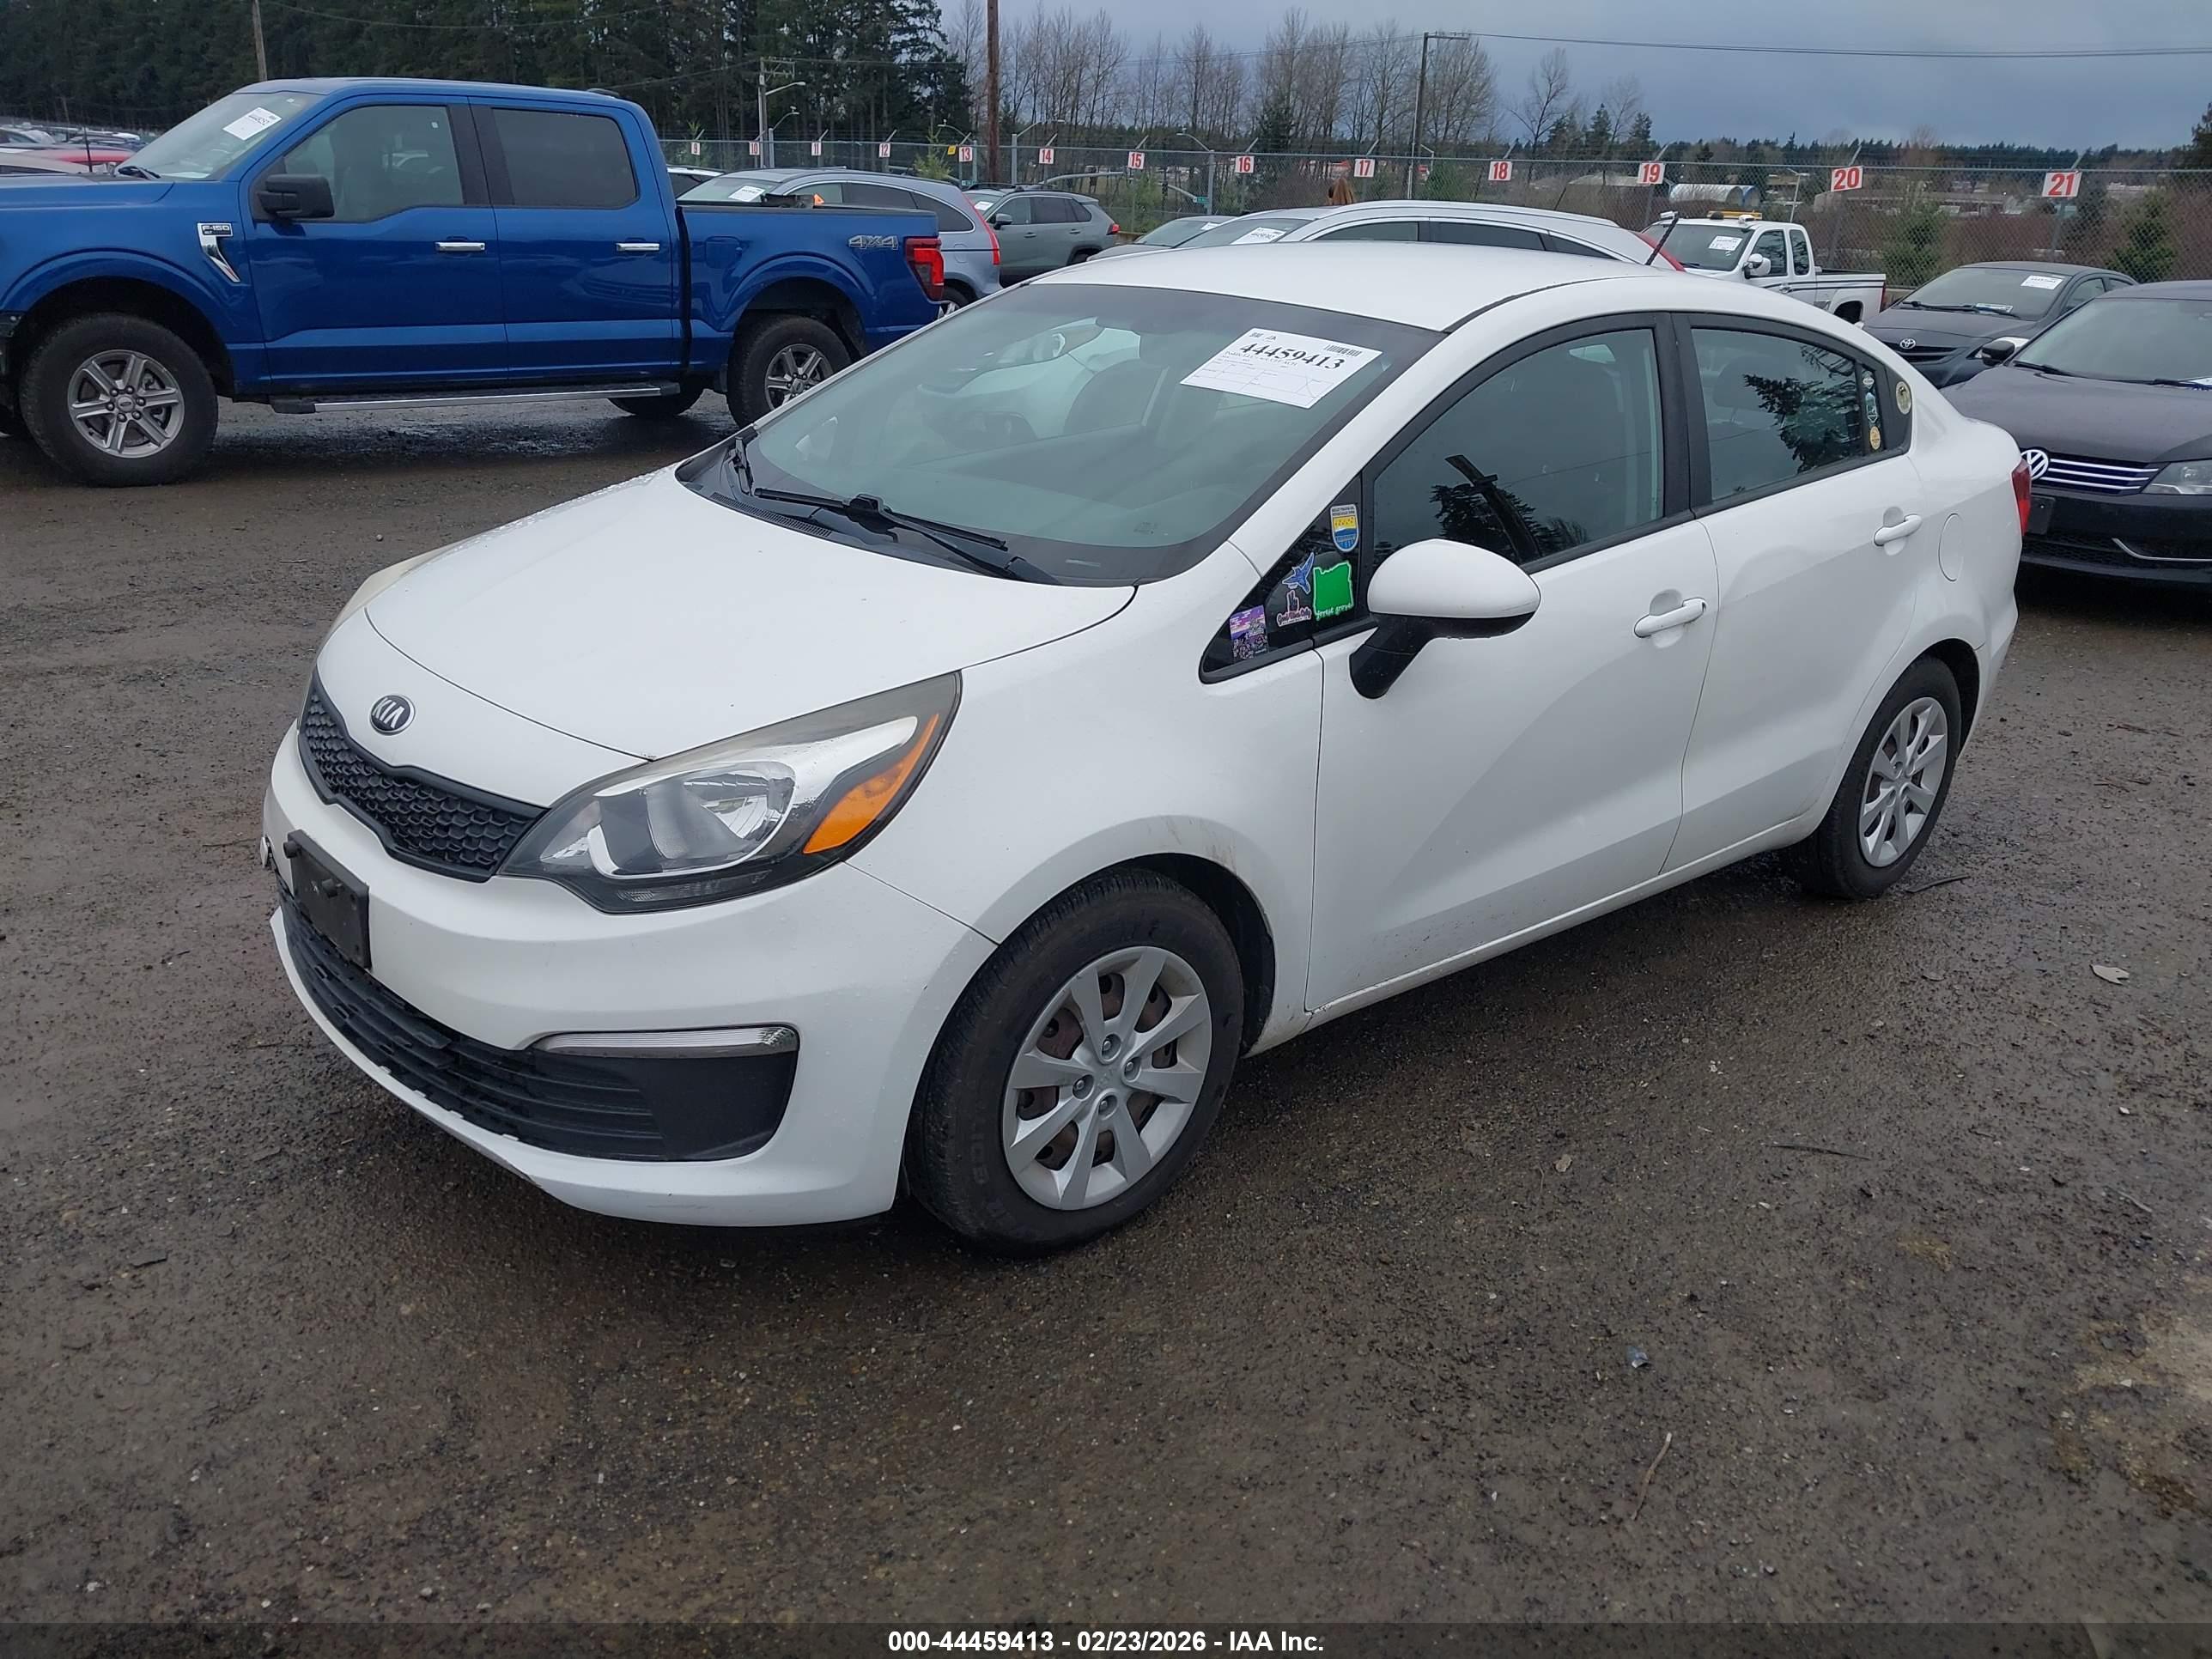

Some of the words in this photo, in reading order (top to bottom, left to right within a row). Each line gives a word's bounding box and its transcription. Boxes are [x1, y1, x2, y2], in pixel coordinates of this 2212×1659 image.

[751, 143, 758, 154] 10
[813, 143, 819, 155] 11
[881, 143, 889, 156] 12
[961, 147, 970, 161] 13
[1042, 149, 1052, 163] 14
[1130, 153, 1142, 168] 15
[1238, 156, 1251, 172] 16
[1358, 160, 1371, 176] 17
[1492, 161, 1509, 179] 18
[1643, 163, 1661, 183] 19
[1833, 167, 1860, 191] 20
[2048, 173, 2075, 196] 21
[1240, 343, 1346, 369] 44459413
[372, 696, 405, 729] KIA
